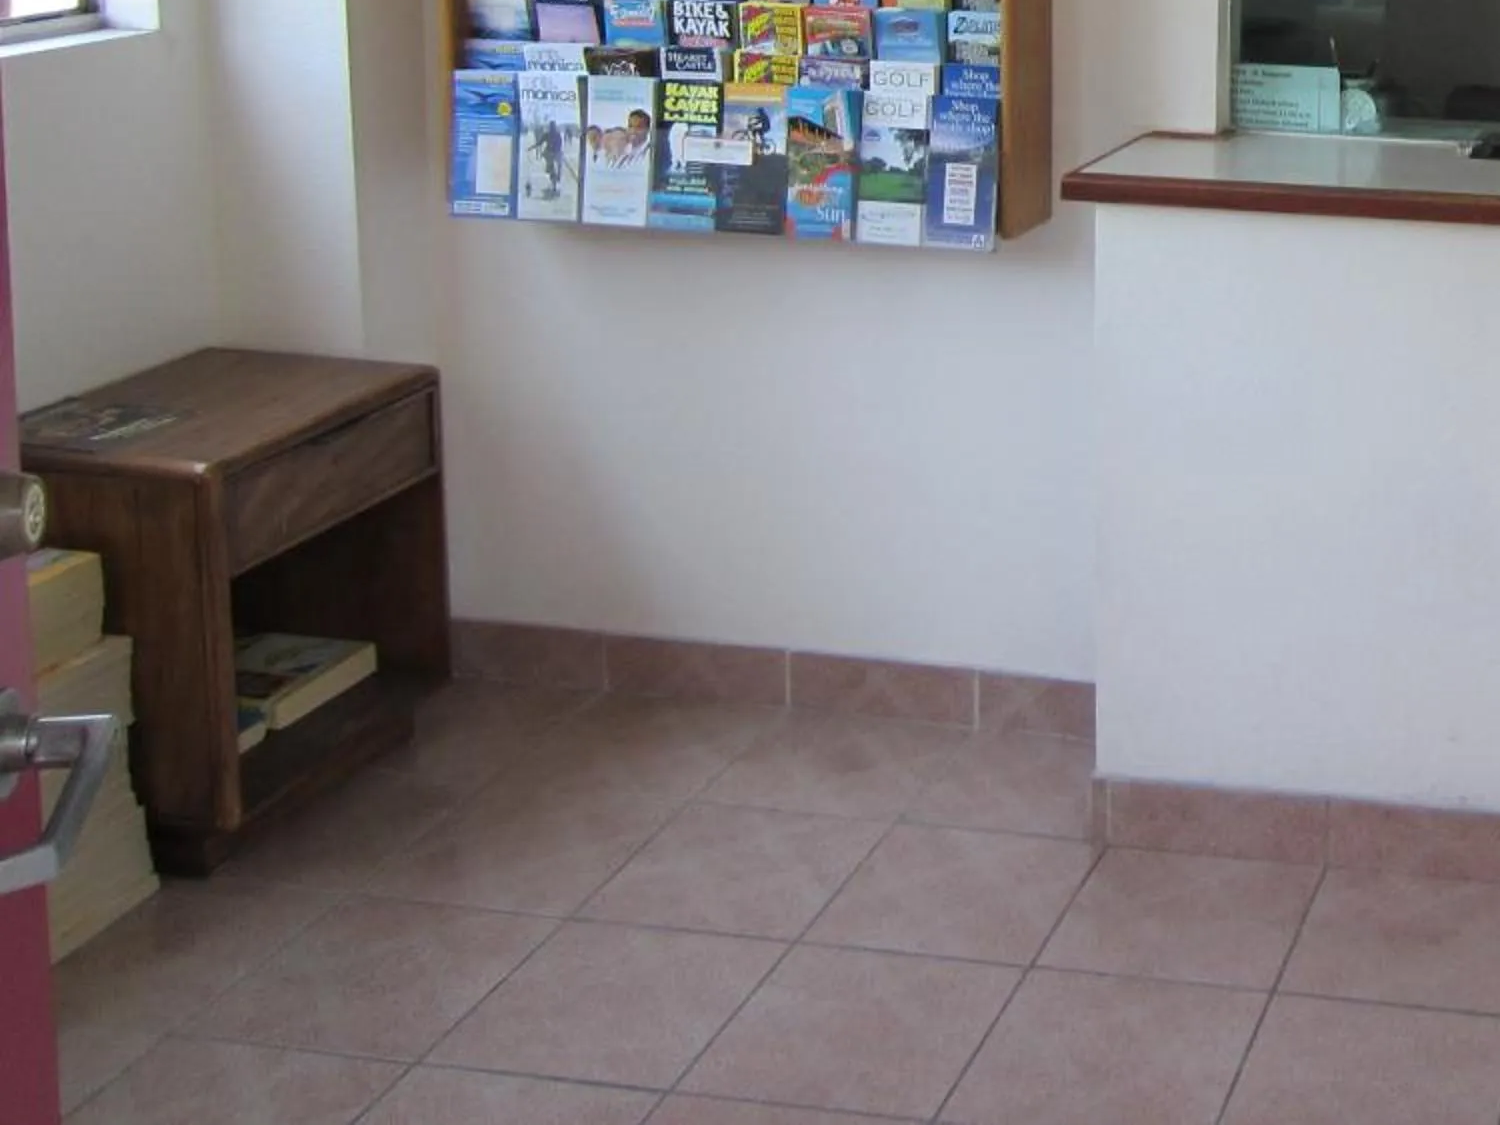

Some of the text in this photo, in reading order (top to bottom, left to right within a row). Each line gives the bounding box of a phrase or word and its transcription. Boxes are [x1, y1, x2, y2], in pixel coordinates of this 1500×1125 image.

[674, 17, 731, 38] KAYAK
[873, 71, 930, 88] GOLF
[521, 89, 577, 102] monica
[865, 101, 922, 118] GOLF
